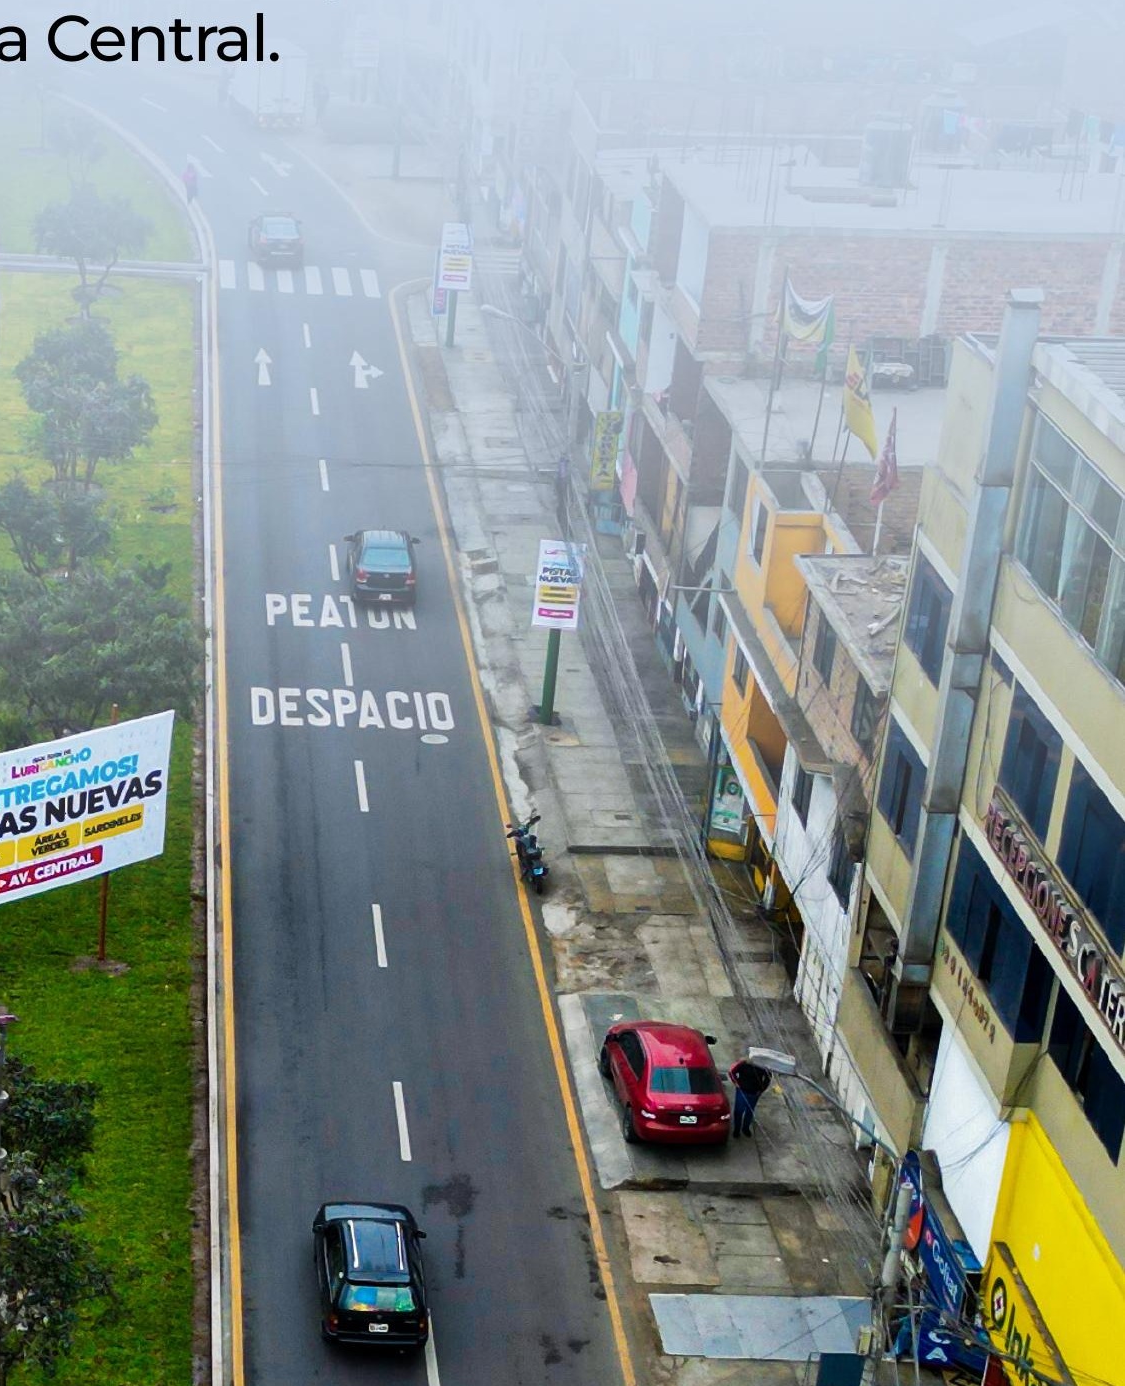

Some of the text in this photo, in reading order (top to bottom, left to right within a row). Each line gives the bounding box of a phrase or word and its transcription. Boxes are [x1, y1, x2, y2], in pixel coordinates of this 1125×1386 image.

[251, 687, 455, 730] DESPACIO
[11, 747, 91, 779] LURIGANCHO
[45, 769, 163, 827] NUEVAS
[7, 853, 95, 888] AV. CENTRAL
